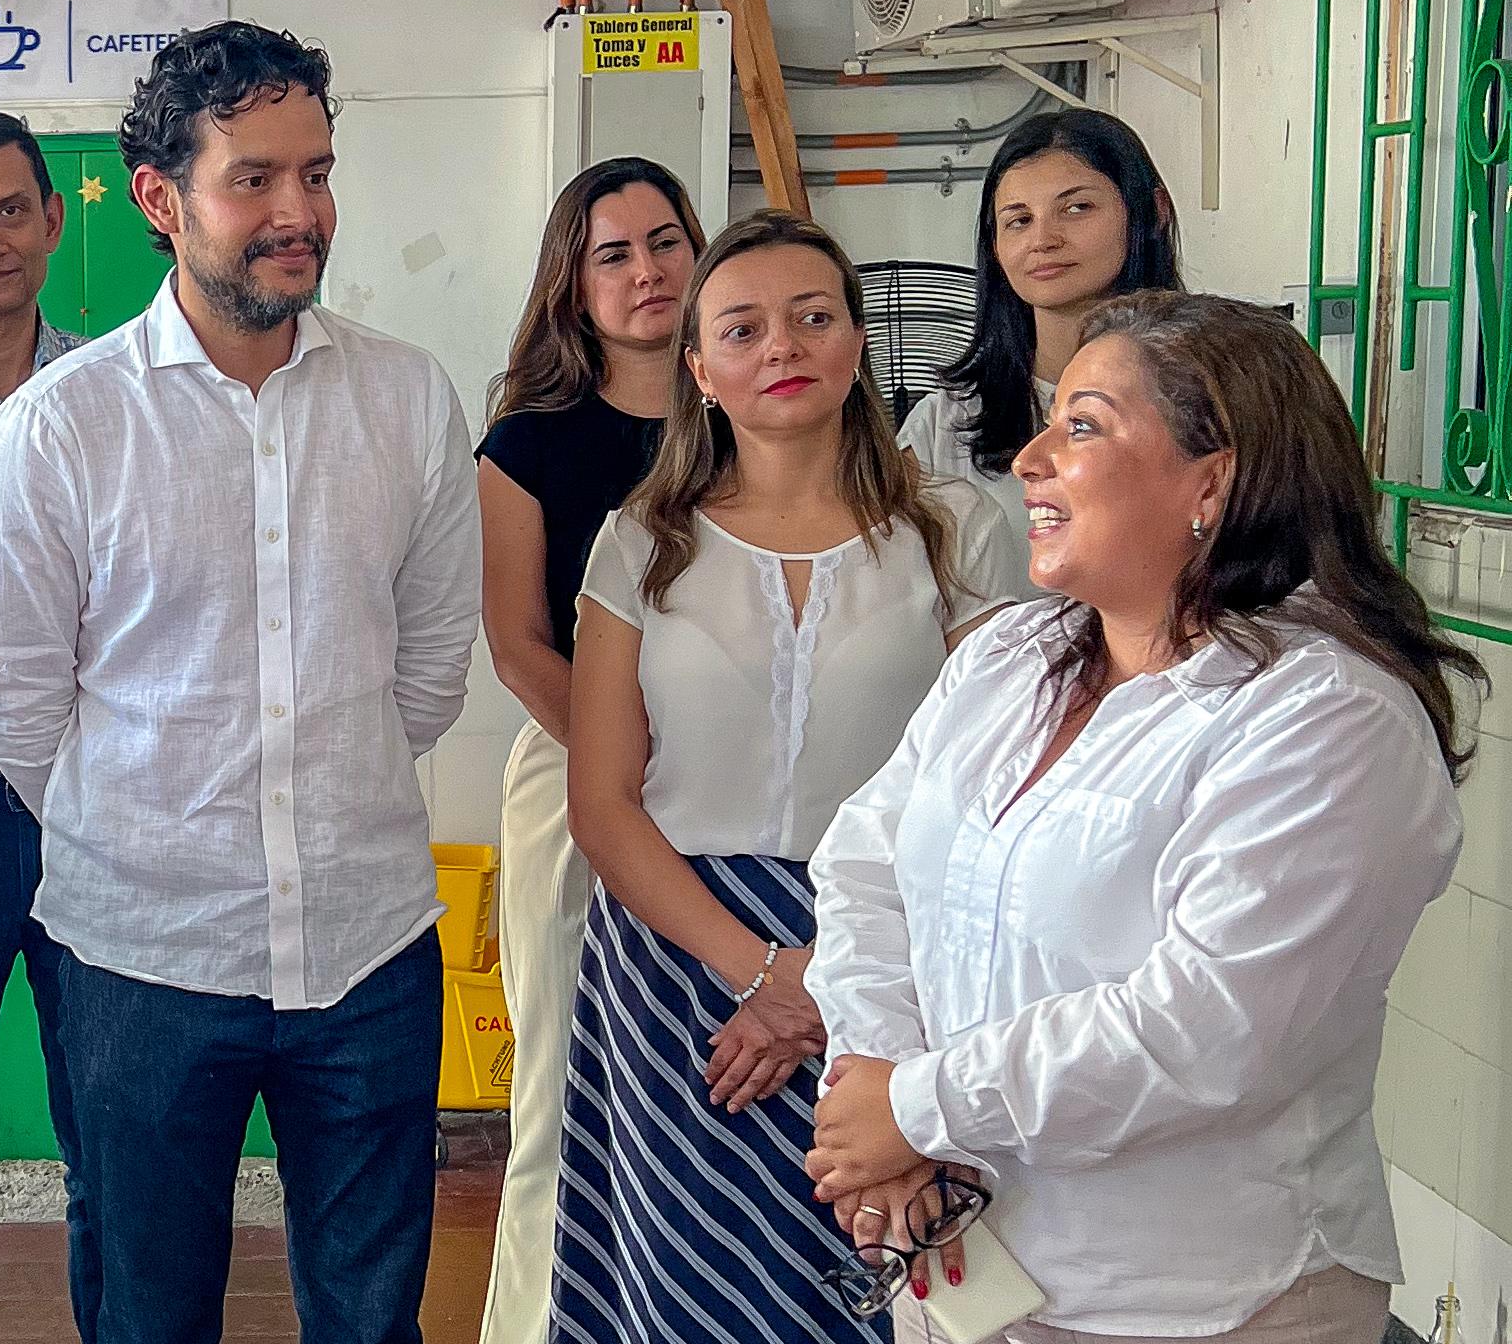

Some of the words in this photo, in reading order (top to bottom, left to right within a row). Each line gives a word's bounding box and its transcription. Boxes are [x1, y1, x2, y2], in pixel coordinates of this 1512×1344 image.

[589, 19, 639, 35] Tablero
[641, 17, 693, 33] General
[593, 37, 635, 53] Toma
[637, 38, 647, 53] y
[656, 41, 685, 64] AA
[596, 53, 641, 69] Luces
